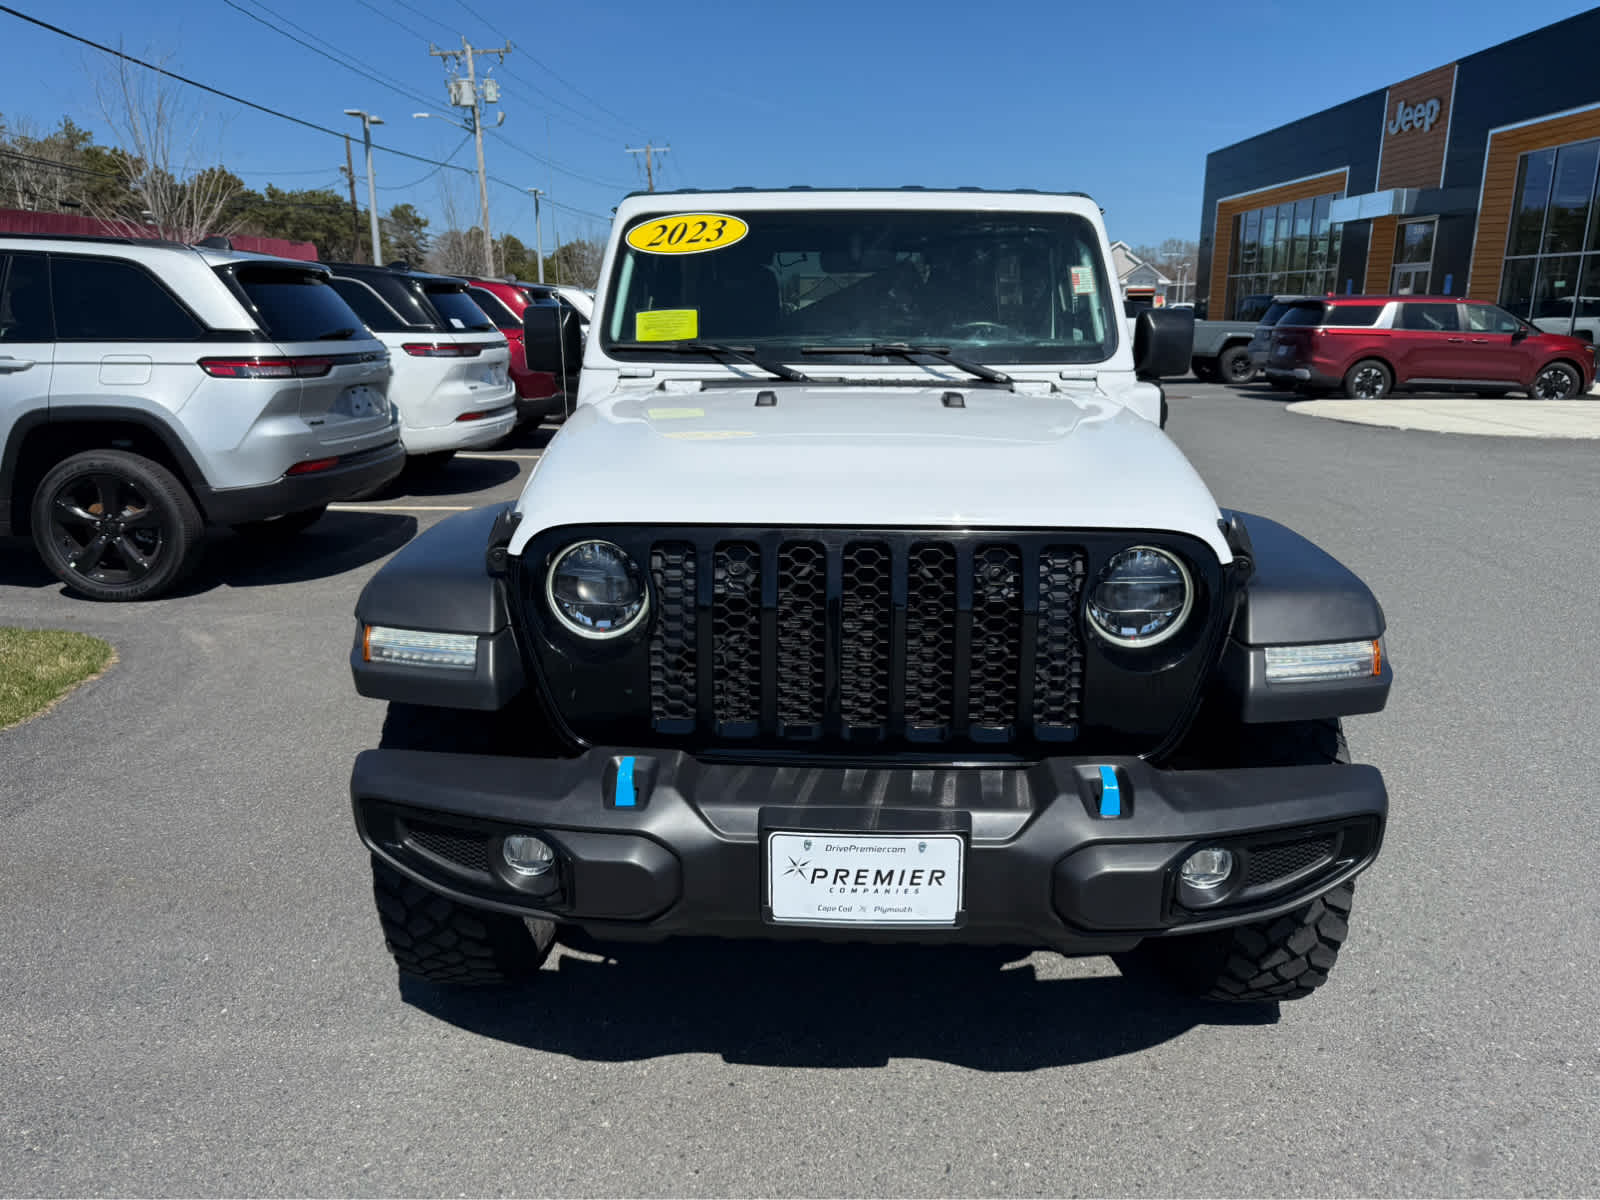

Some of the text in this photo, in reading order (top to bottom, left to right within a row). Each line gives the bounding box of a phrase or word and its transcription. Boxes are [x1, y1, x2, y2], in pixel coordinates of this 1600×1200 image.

[1388, 99, 1440, 135] Jeep
[647, 220, 727, 247] 2023
[810, 868, 946, 886] PREMIER
[829, 887, 920, 895] COMPANIES
[817, 904, 913, 914] Cape Cod Plymouth
